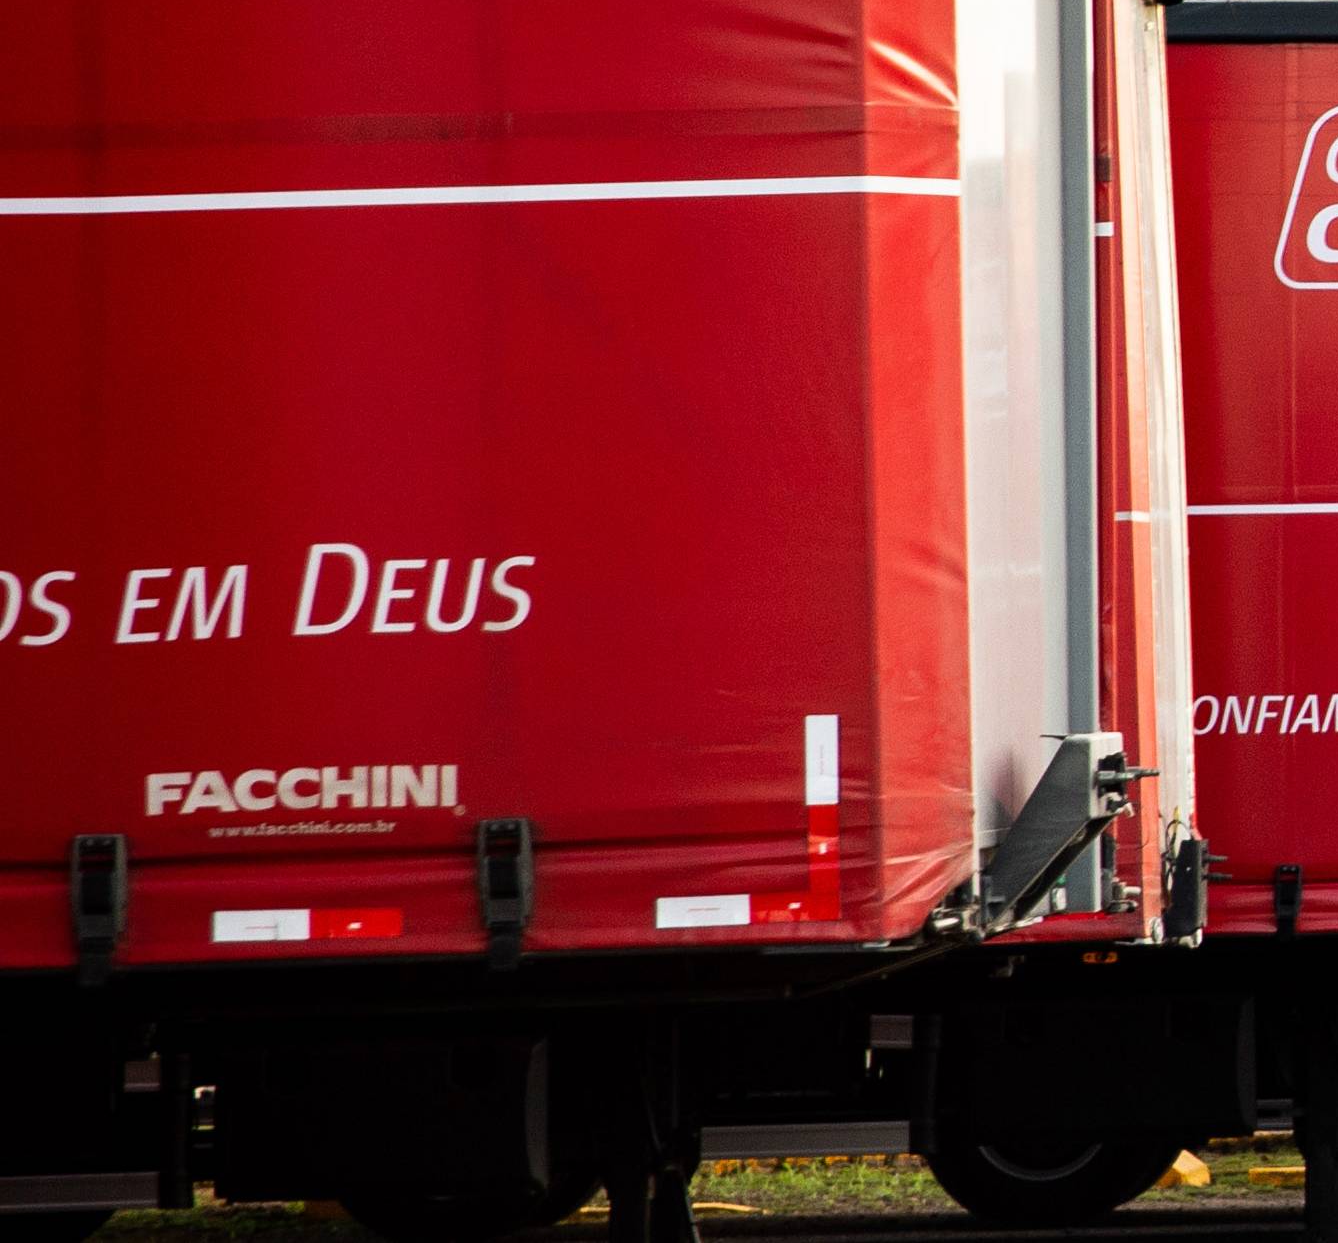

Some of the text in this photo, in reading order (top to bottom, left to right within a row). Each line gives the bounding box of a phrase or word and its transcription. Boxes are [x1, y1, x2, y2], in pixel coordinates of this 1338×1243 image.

[115, 564, 248, 644] EM
[145, 764, 459, 816] FACCHINI
[207, 819, 397, 838] www.facchini.com.br
